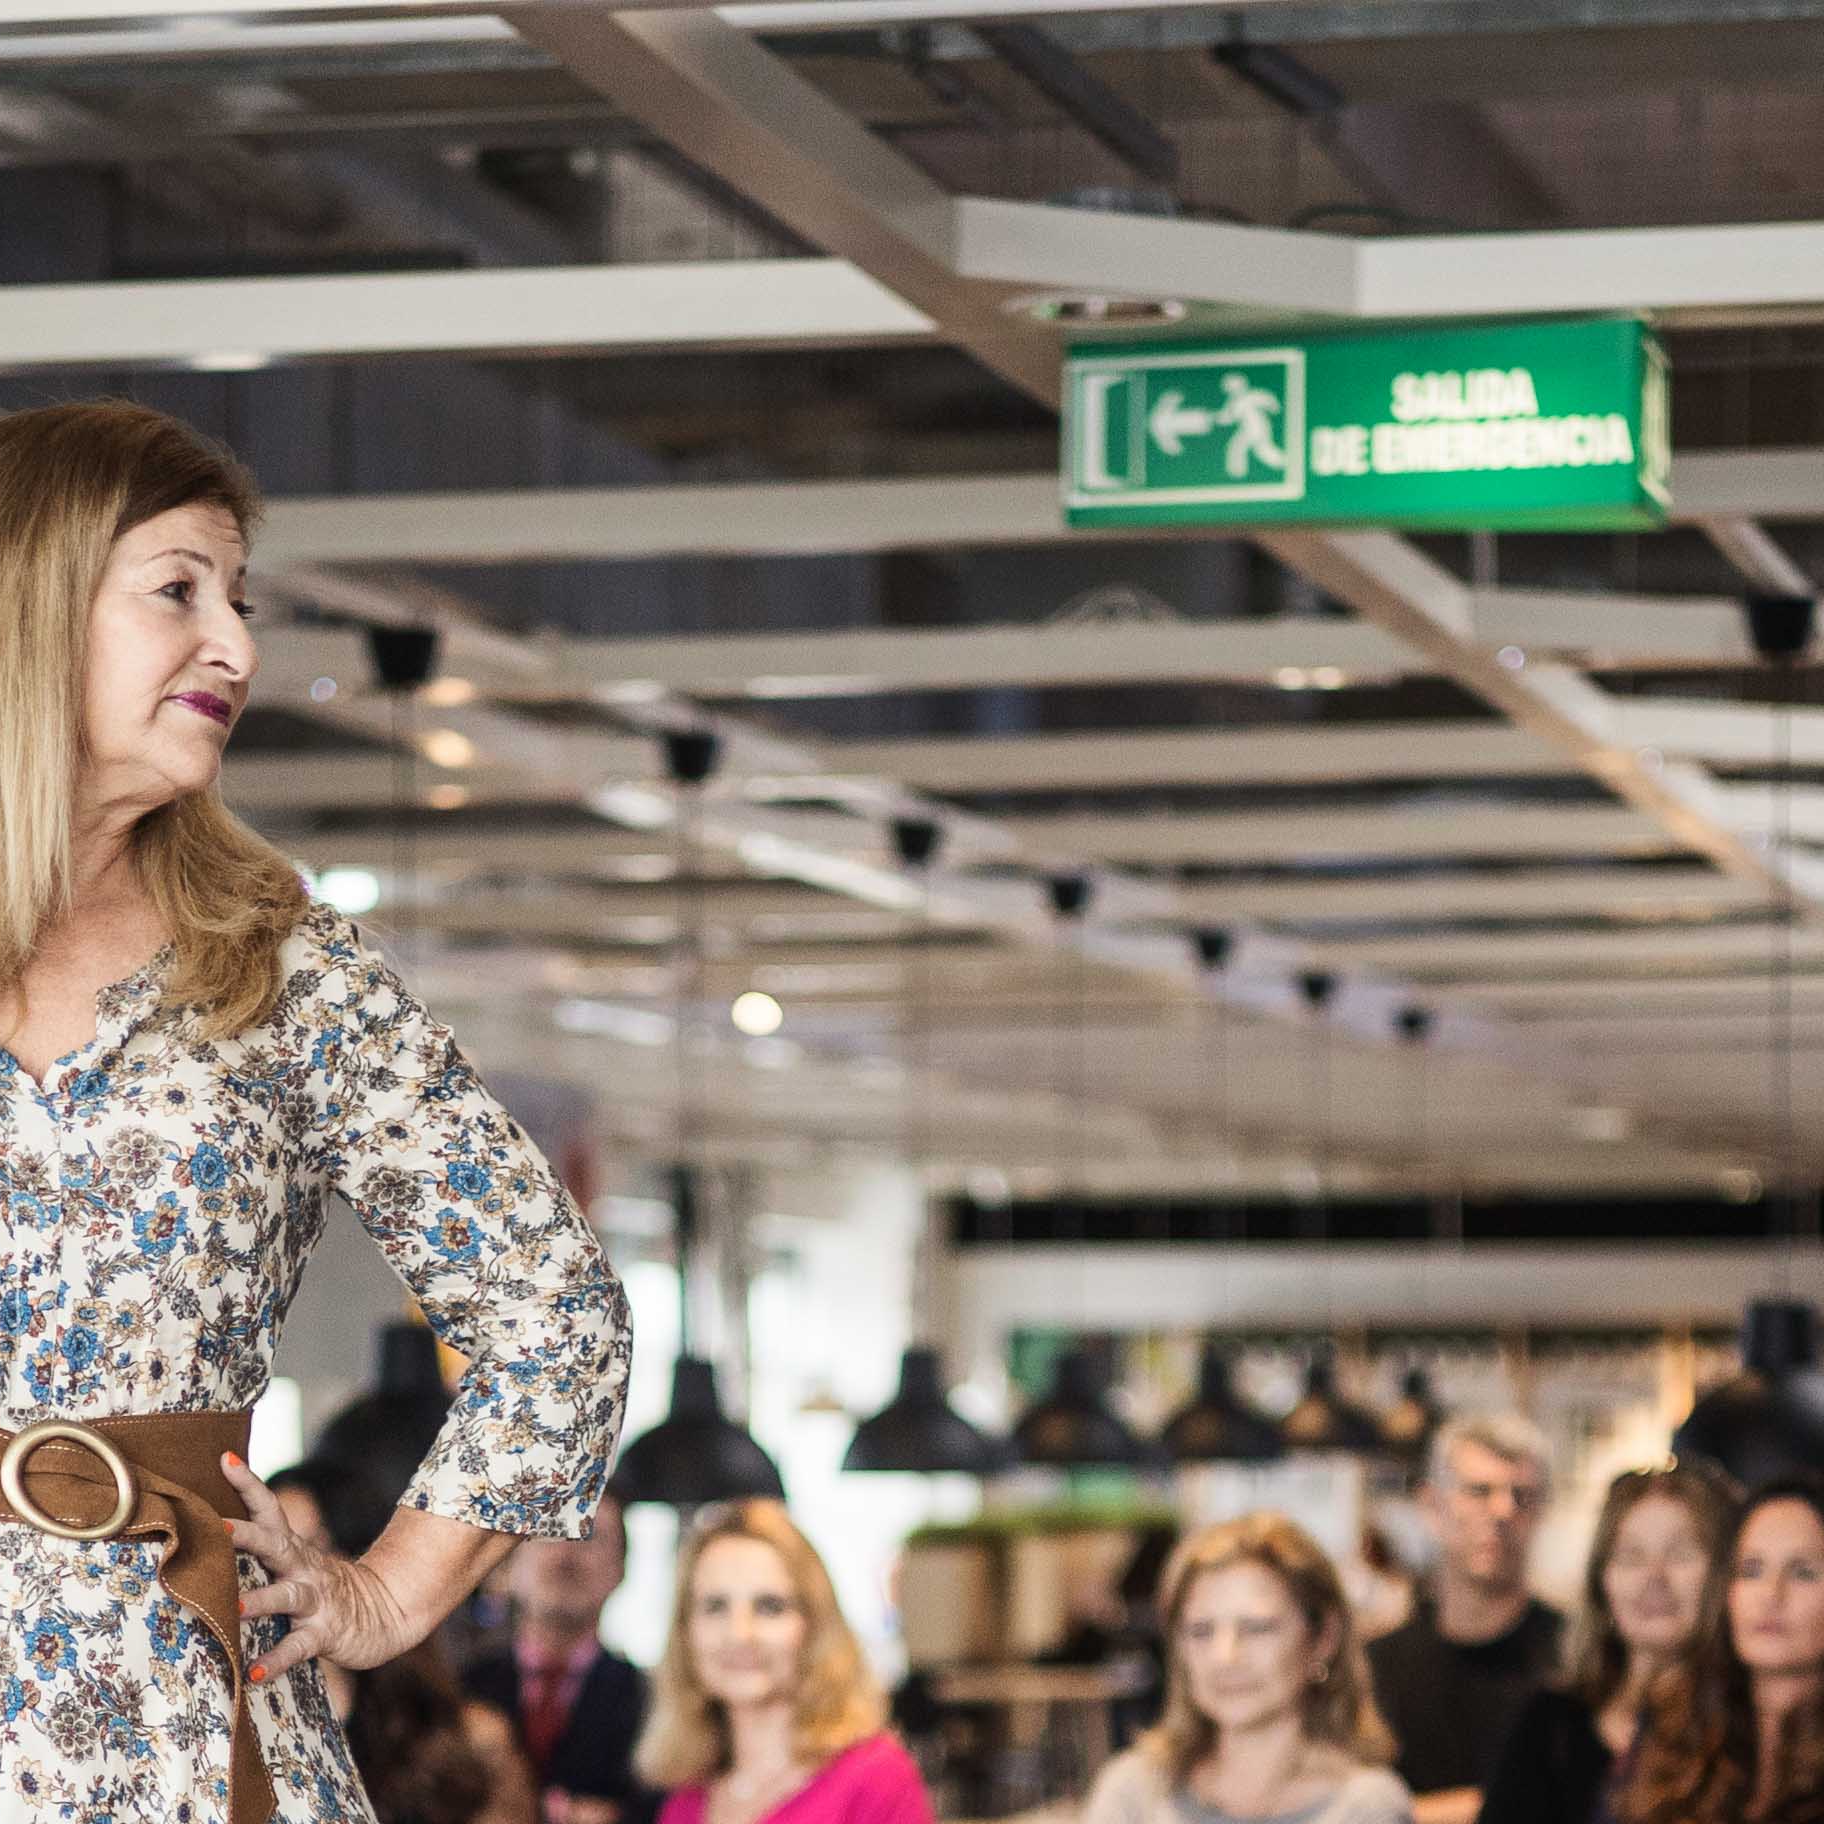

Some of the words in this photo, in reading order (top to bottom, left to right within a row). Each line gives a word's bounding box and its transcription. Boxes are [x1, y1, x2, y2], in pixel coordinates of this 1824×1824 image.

[1391, 367, 1539, 422] SALIDA
[1310, 425, 1370, 475] DE
[1373, 413, 1635, 475] EMERGENCIA
